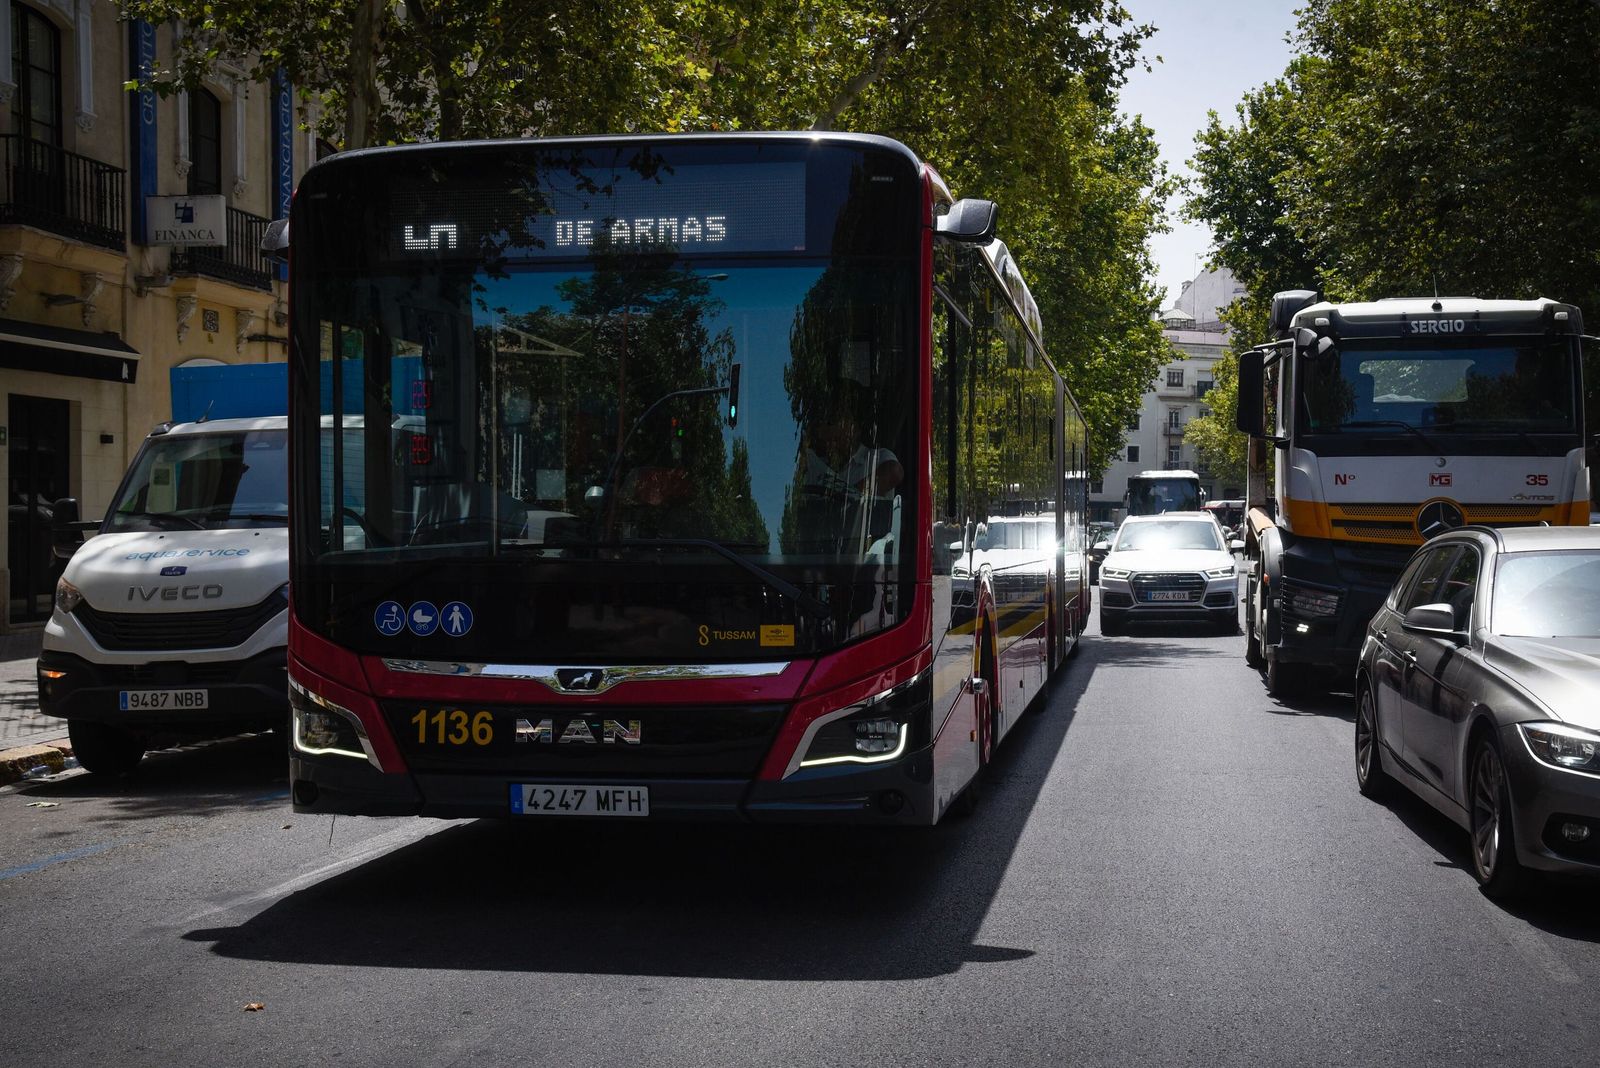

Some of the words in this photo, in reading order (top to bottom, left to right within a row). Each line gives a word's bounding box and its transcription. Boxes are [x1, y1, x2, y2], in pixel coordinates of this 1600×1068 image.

[155, 230, 215, 241] FINANCA
[556, 220, 593, 246] DE
[611, 216, 726, 245] ARMAS
[1410, 319, 1465, 334] SERGIO
[1431, 474, 1451, 485] MG
[1526, 474, 1549, 486] 35
[126, 549, 250, 562] aquaservice
[128, 584, 223, 601] IVECO
[1153, 592, 1170, 600] 2774
[712, 630, 756, 640] TUSSAM
[131, 693, 169, 707] 9487
[174, 692, 204, 707] NBB
[411, 708, 495, 746] 1136
[515, 718, 642, 745] MAN
[528, 789, 587, 811] 4247
[596, 789, 642, 812] MFH
